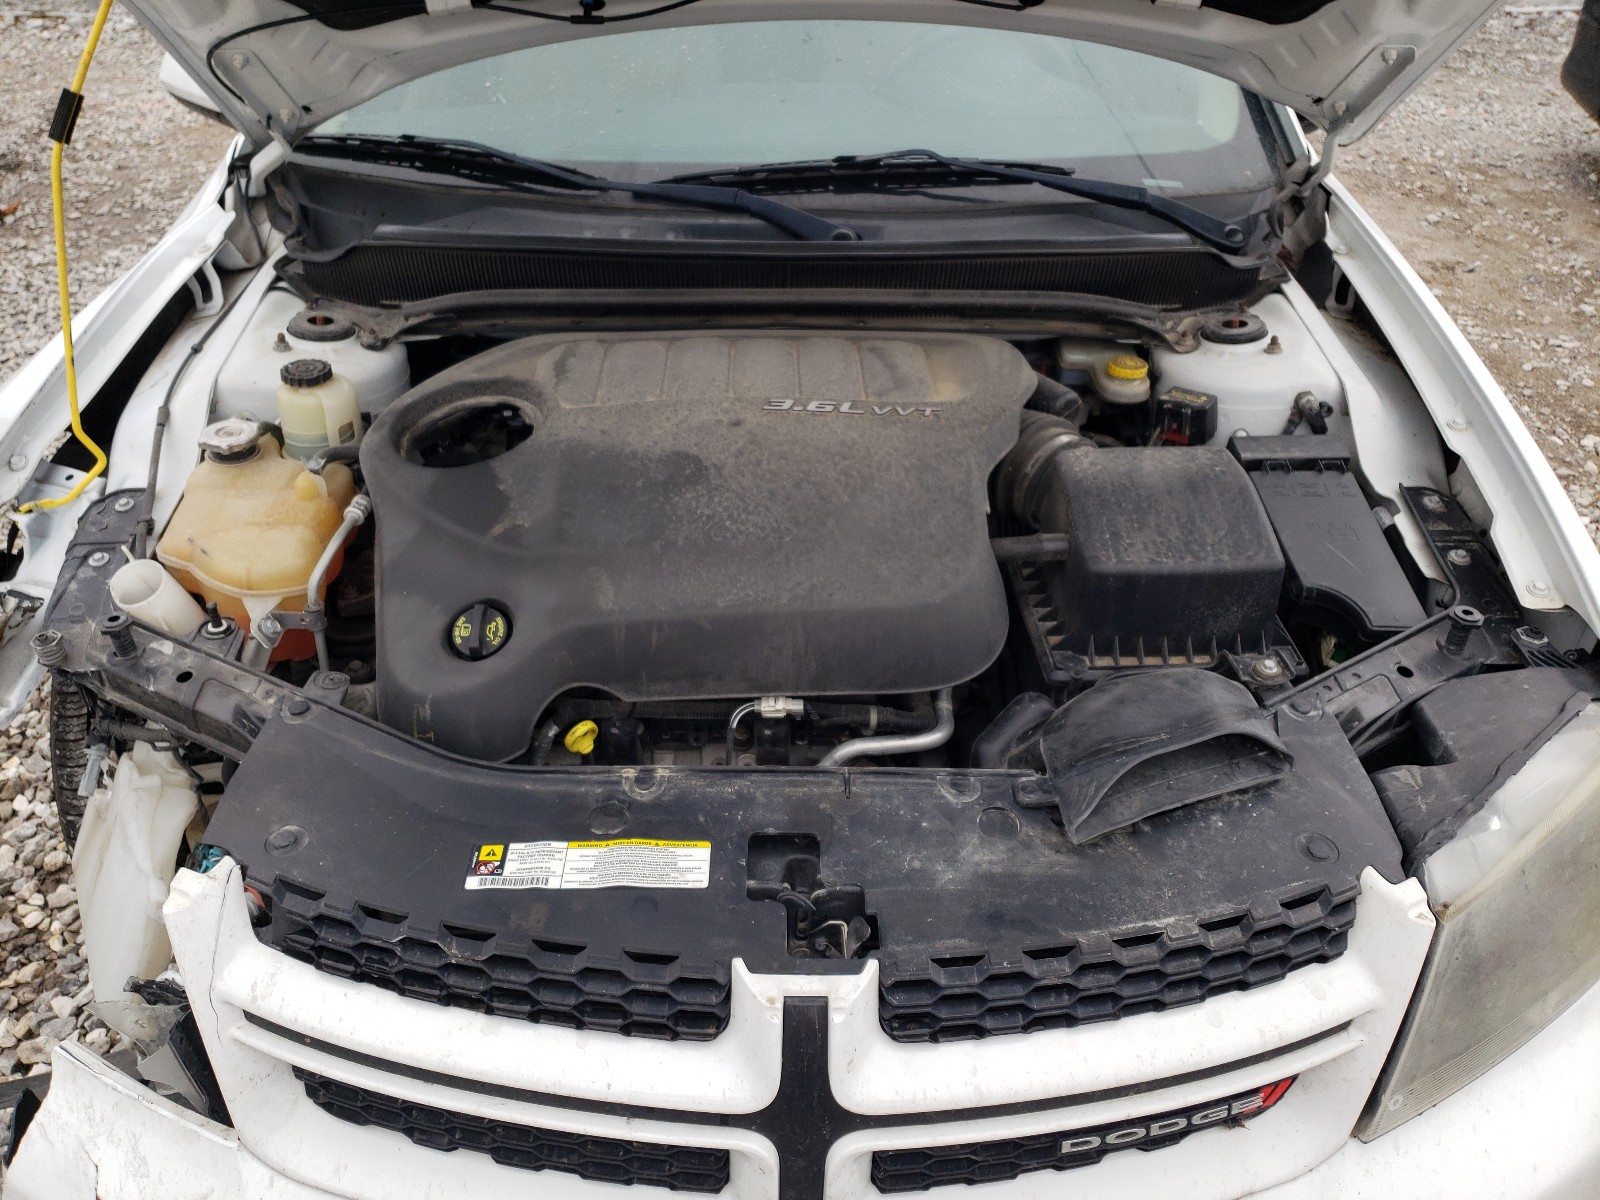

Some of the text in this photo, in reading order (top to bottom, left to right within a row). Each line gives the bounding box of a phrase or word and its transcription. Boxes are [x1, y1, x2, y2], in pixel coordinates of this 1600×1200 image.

[762, 399, 941, 416] 3.6L VVT
[1061, 1092, 1265, 1154] DODGE
